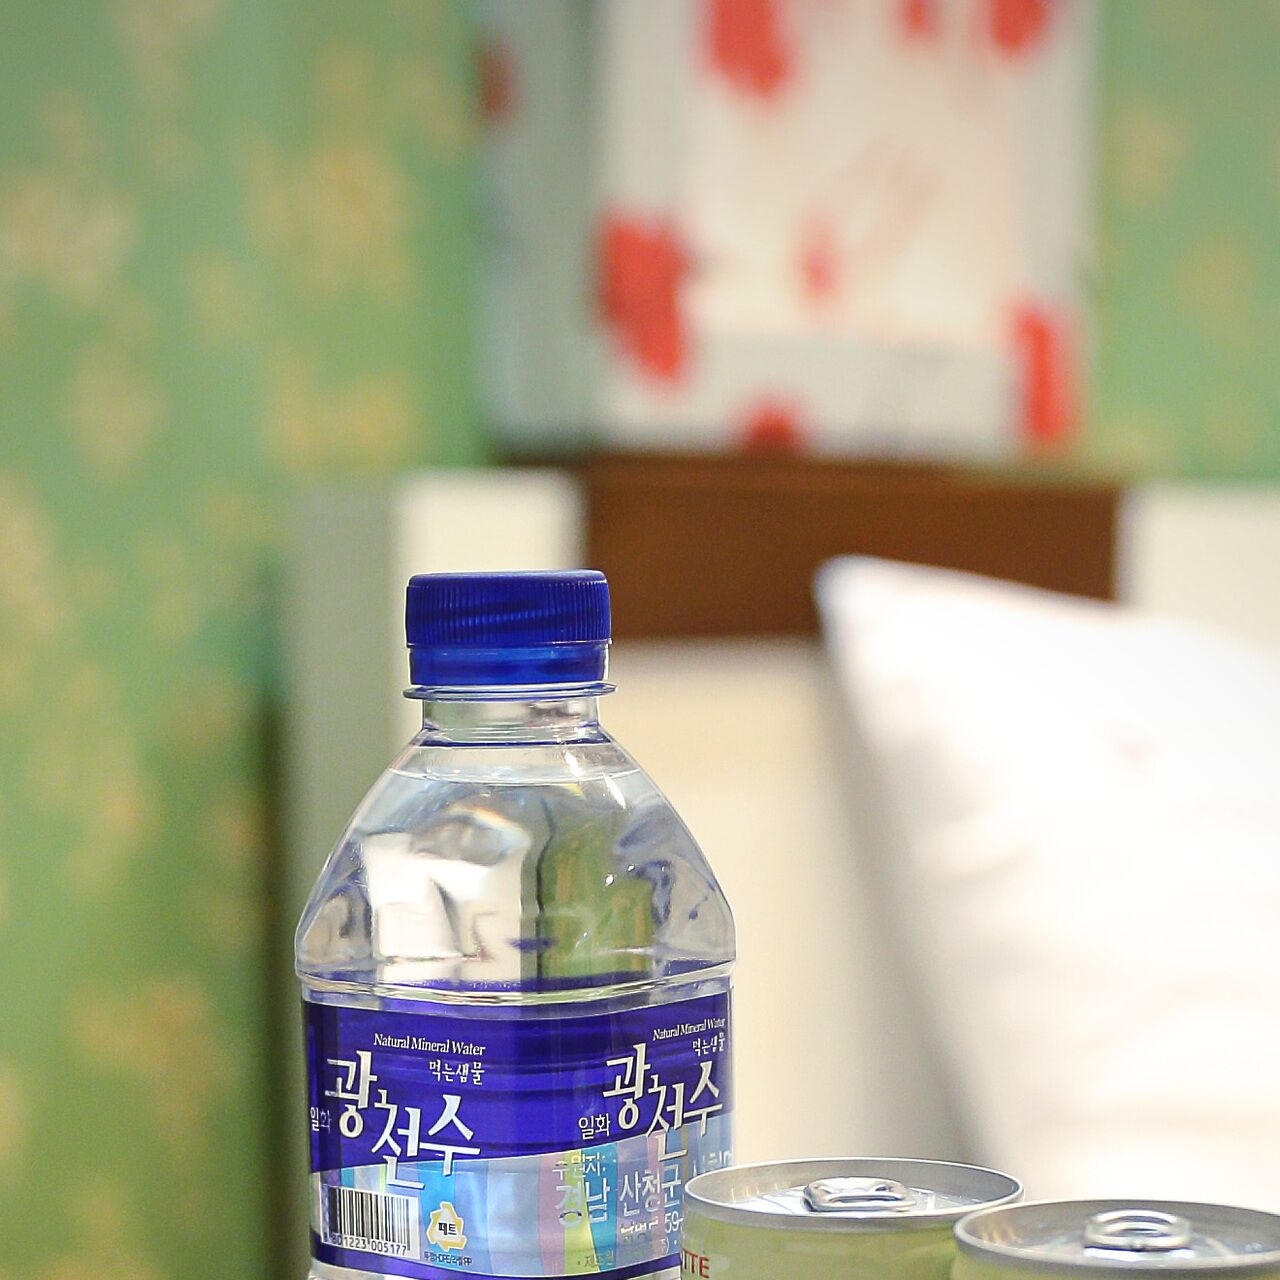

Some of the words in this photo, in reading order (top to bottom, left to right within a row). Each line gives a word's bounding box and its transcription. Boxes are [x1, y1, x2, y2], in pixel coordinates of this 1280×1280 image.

[652, 1024, 680, 1041] Natural
[680, 1019, 707, 1036] Mineral
[373, 1033, 410, 1049] Natural
[411, 1036, 450, 1053] Mineral
[452, 1040, 486, 1056] Water
[428, 1059, 486, 1085] 먹는샘물
[602, 1042, 723, 1161] 광천수
[324, 1050, 481, 1189] 광천수
[578, 1113, 611, 1140] 일화
[554, 1177, 611, 1229] 경남
[620, 1163, 682, 1217] 산청군
[371, 1240, 407, 1256] 005177
[682, 1249, 710, 1279] TTE
